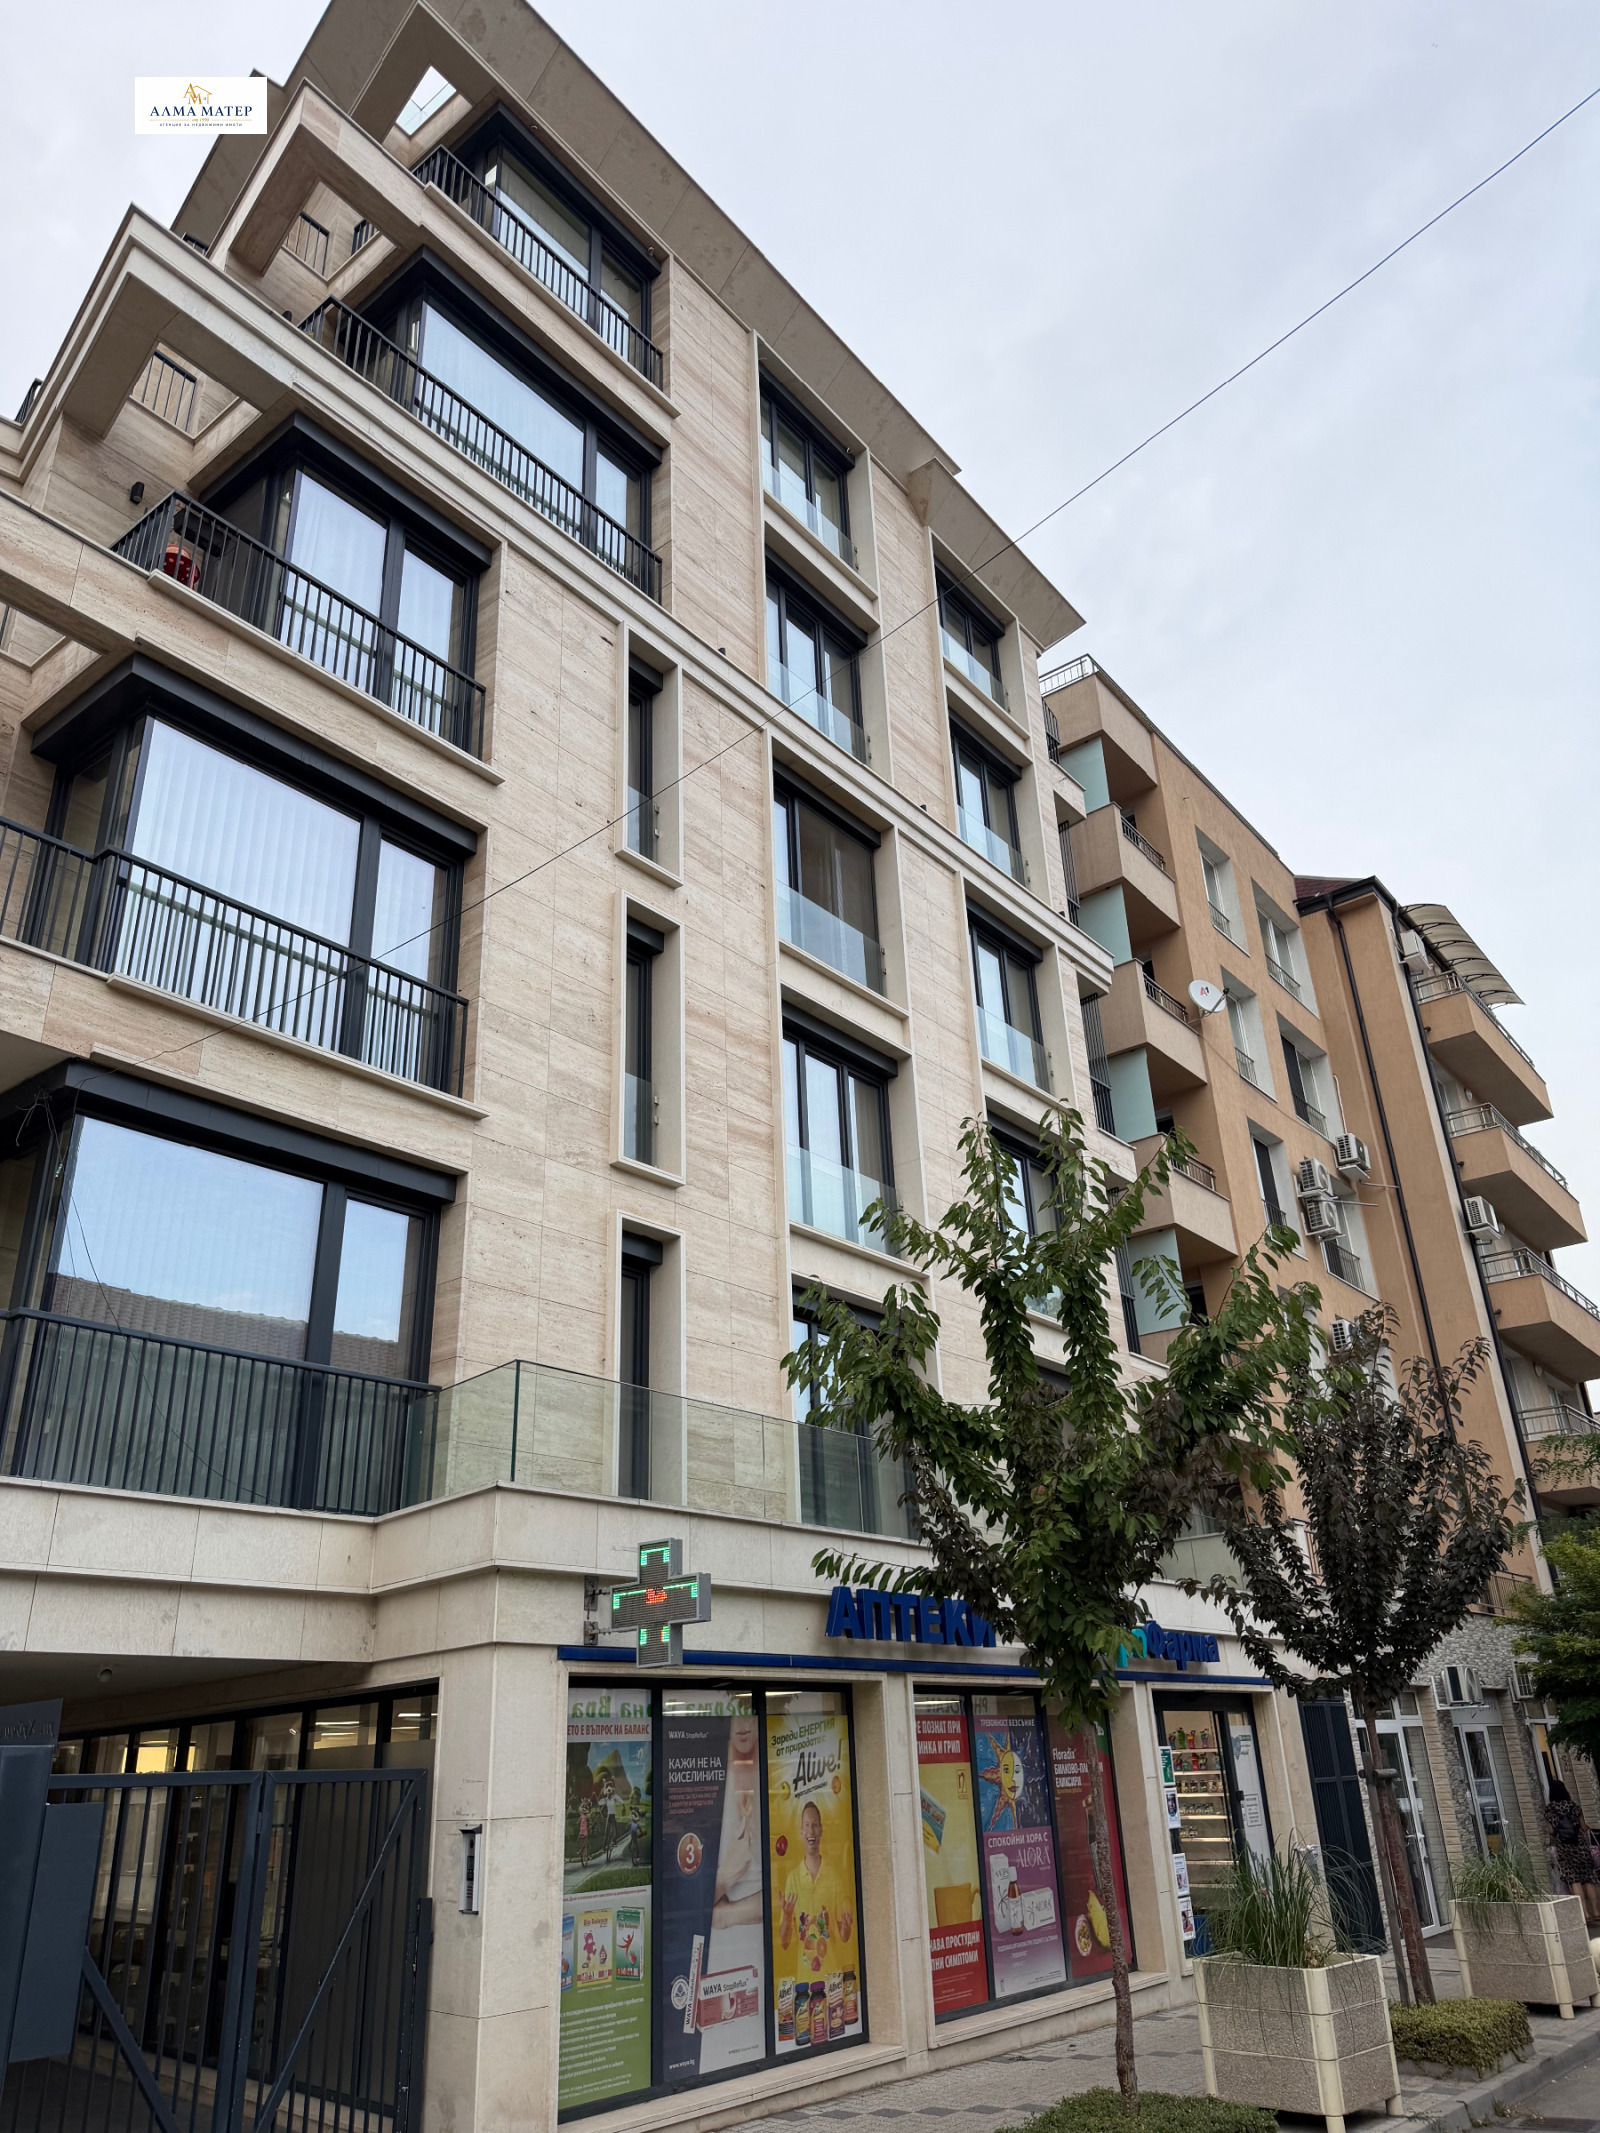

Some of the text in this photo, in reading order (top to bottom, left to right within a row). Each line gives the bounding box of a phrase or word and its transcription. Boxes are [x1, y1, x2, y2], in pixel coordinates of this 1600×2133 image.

[825, 1586, 996, 1648] АПТЕКИ
[586, 1724, 613, 1736] ВЪПРОС
[614, 1723, 623, 1735] НА
[624, 1723, 650, 1735] БАЛАНС
[922, 1720, 946, 1733] ПОЗНАТ
[947, 1720, 961, 1733] ПРИ
[1008, 1718, 1035, 1727] БЕЗСЪНИЕ
[668, 1730, 685, 1739] WAYA
[771, 1717, 835, 1747] Зареди ЕНЕРГИЯ
[775, 1746, 785, 1757] от
[938, 1740, 943, 1753] И
[943, 1739, 961, 1754] ГРИП
[1052, 1747, 1076, 1760] Floradix
[668, 1756, 722, 1770] КАЖИ НЕ НА
[793, 1738, 842, 1792] Alive!
[668, 1770, 726, 1783] КИСЕЛИНИТЕ!
[988, 1831, 1049, 1848] СПОКОЙНИ ХОРА С
[686, 1843, 695, 1864] 3
[945, 1930, 980, 1949] ПРОСТУДНИ
[945, 1949, 978, 1968] СИМПТОМИ
[703, 1983, 722, 1997] WAYA
[685, 2003, 693, 2025] WAYA
